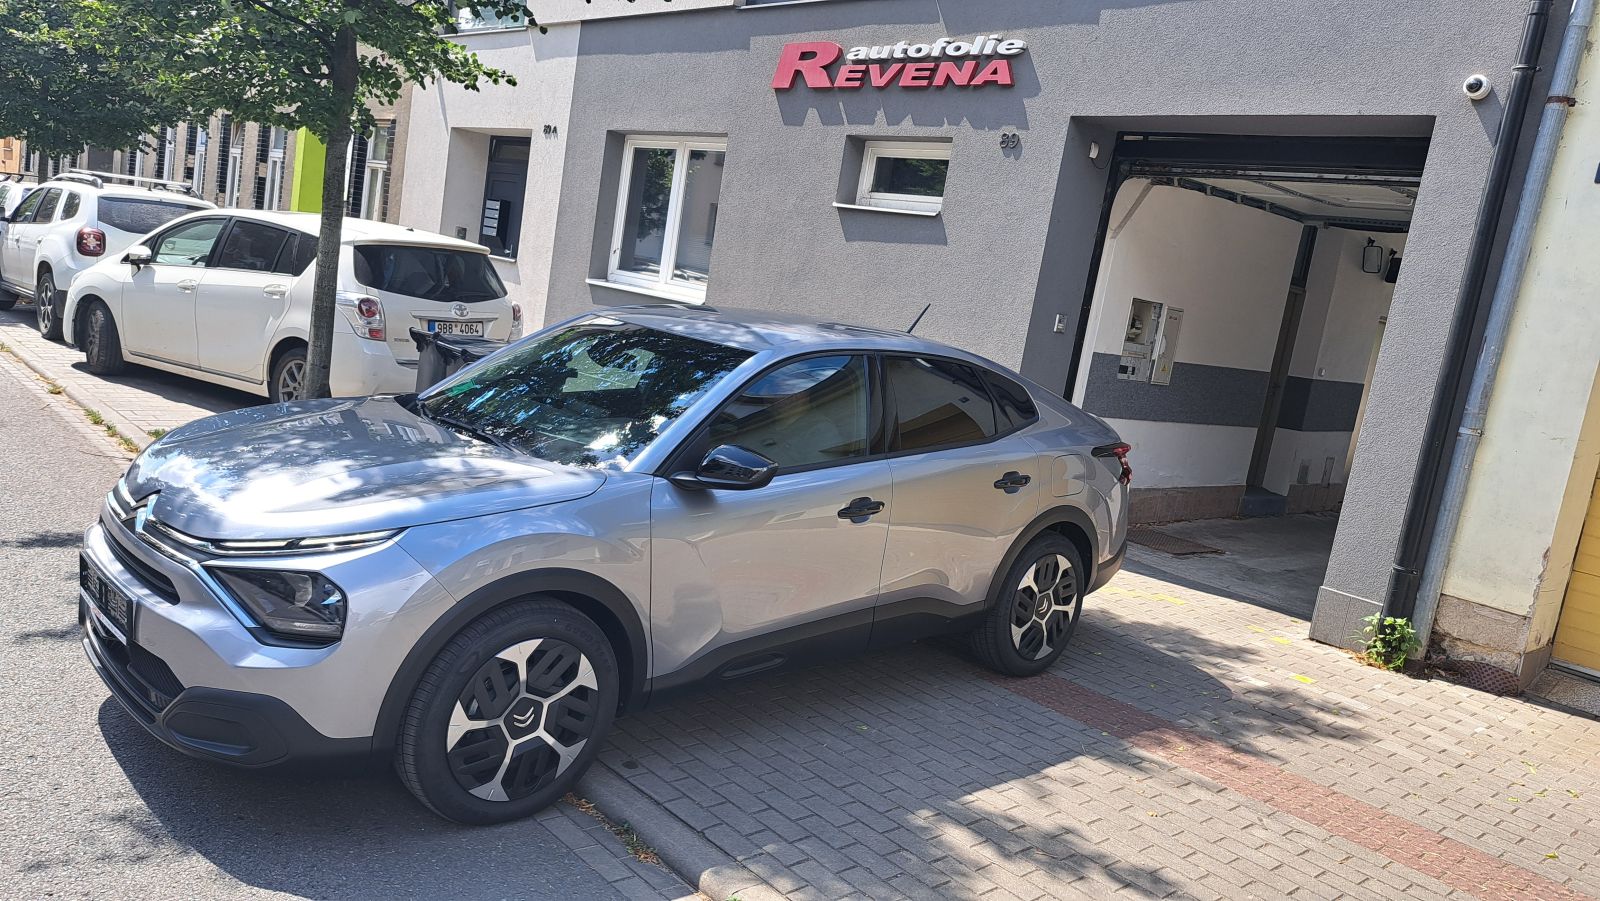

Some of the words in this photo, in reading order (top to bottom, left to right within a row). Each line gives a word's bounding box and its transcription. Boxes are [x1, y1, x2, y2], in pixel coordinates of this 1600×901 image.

[846, 34, 1028, 61] autofolie
[770, 41, 1015, 90] REVENA
[1000, 132, 1020, 149] 89
[437, 323, 453, 334] 9B8
[459, 323, 479, 335] 4064
